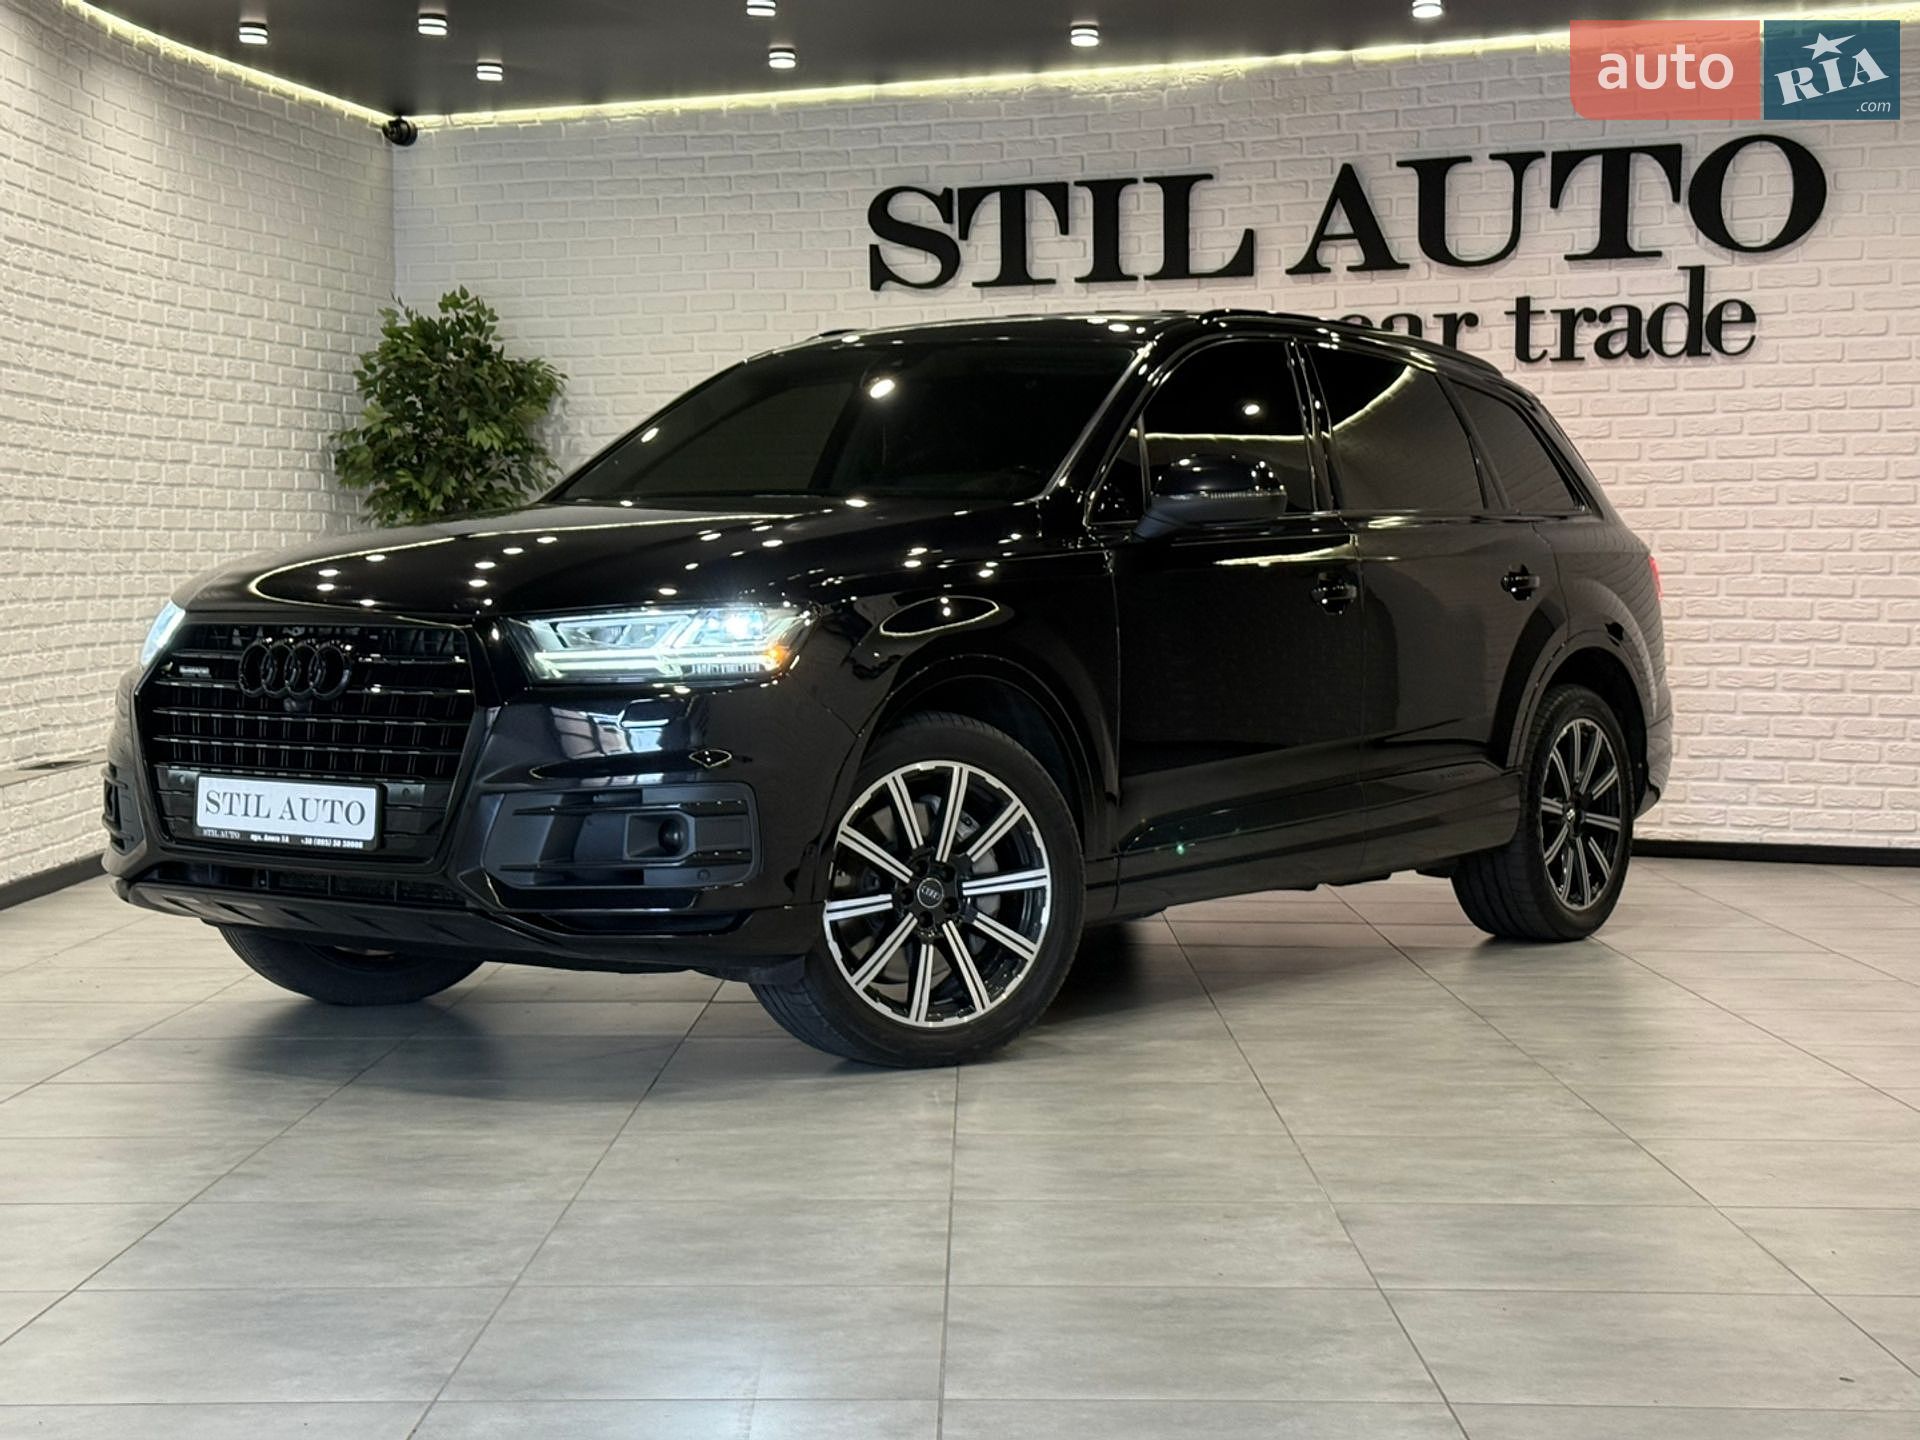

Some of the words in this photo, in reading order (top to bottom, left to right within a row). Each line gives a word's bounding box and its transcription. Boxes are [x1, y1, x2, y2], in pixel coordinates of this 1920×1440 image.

[868, 173, 1255, 291] STIL
[1286, 133, 1828, 276] AUTO
[1505, 265, 1758, 363] trade
[205, 790, 271, 819] STIL
[278, 797, 366, 826] AUTO
